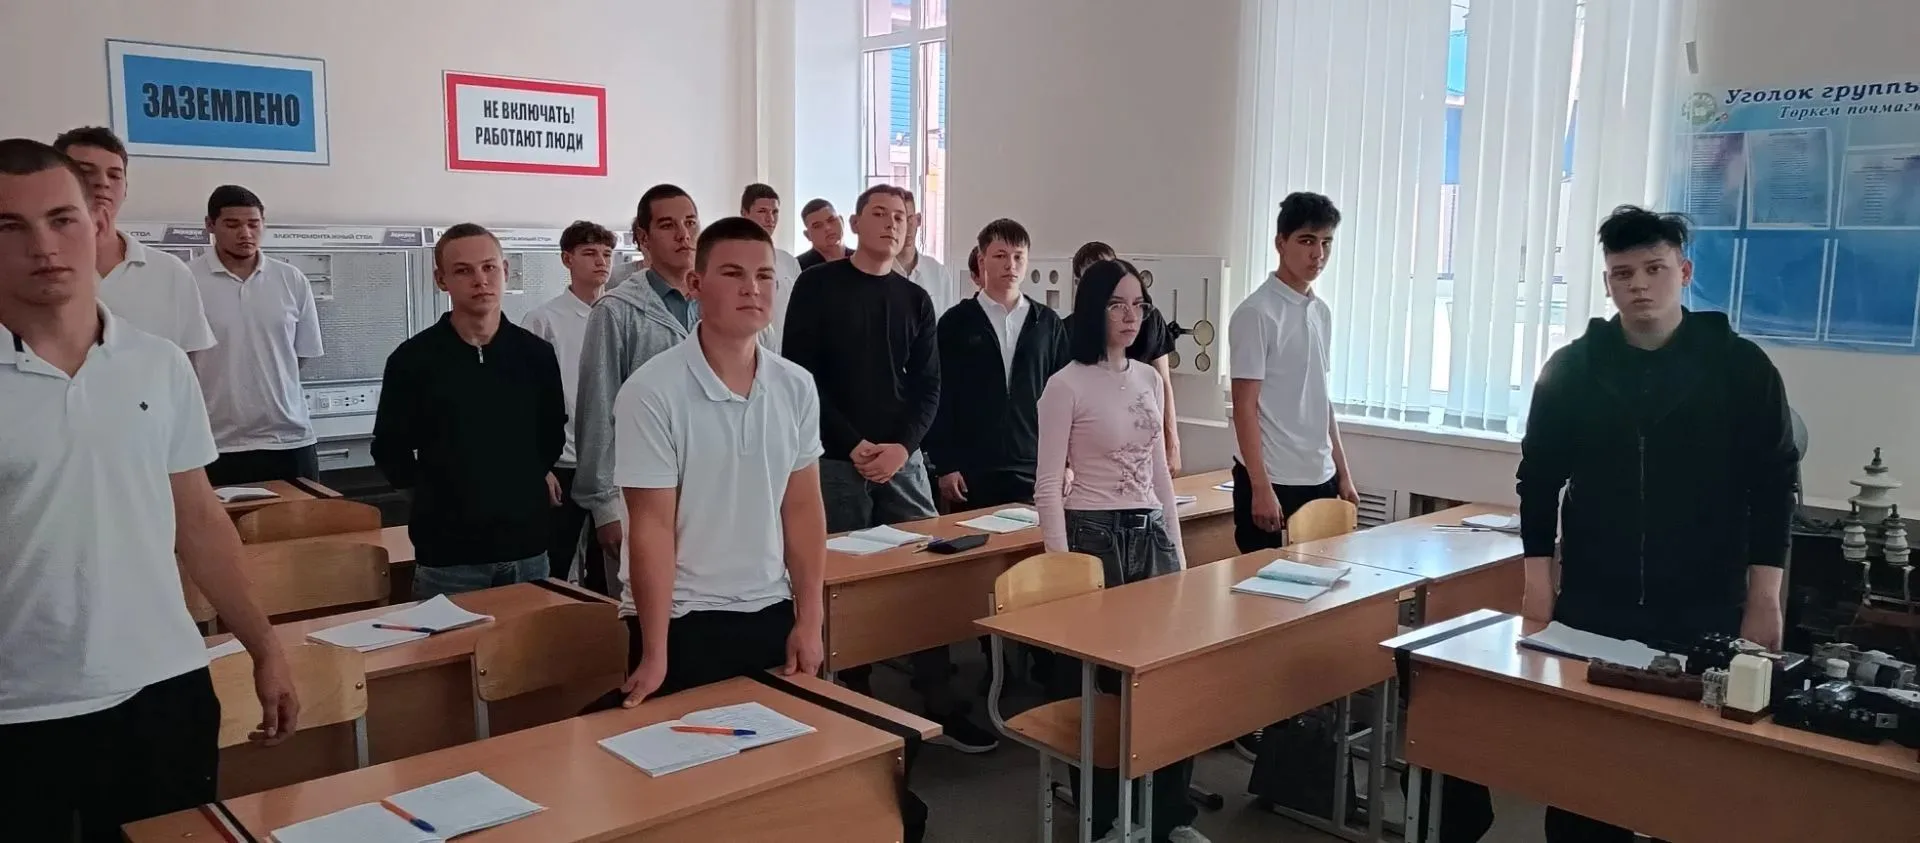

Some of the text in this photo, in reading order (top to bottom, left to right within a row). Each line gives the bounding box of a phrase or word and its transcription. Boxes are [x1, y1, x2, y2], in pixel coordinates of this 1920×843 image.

[142, 82, 300, 127] ЗАЗЕМЛЕНО
[1725, 87, 1814, 104] Уголок
[483, 100, 575, 124] НЕ ВКЛЮЧАТЬ!
[475, 126, 584, 152] РАБОТАЮТ ЛЮДИ
